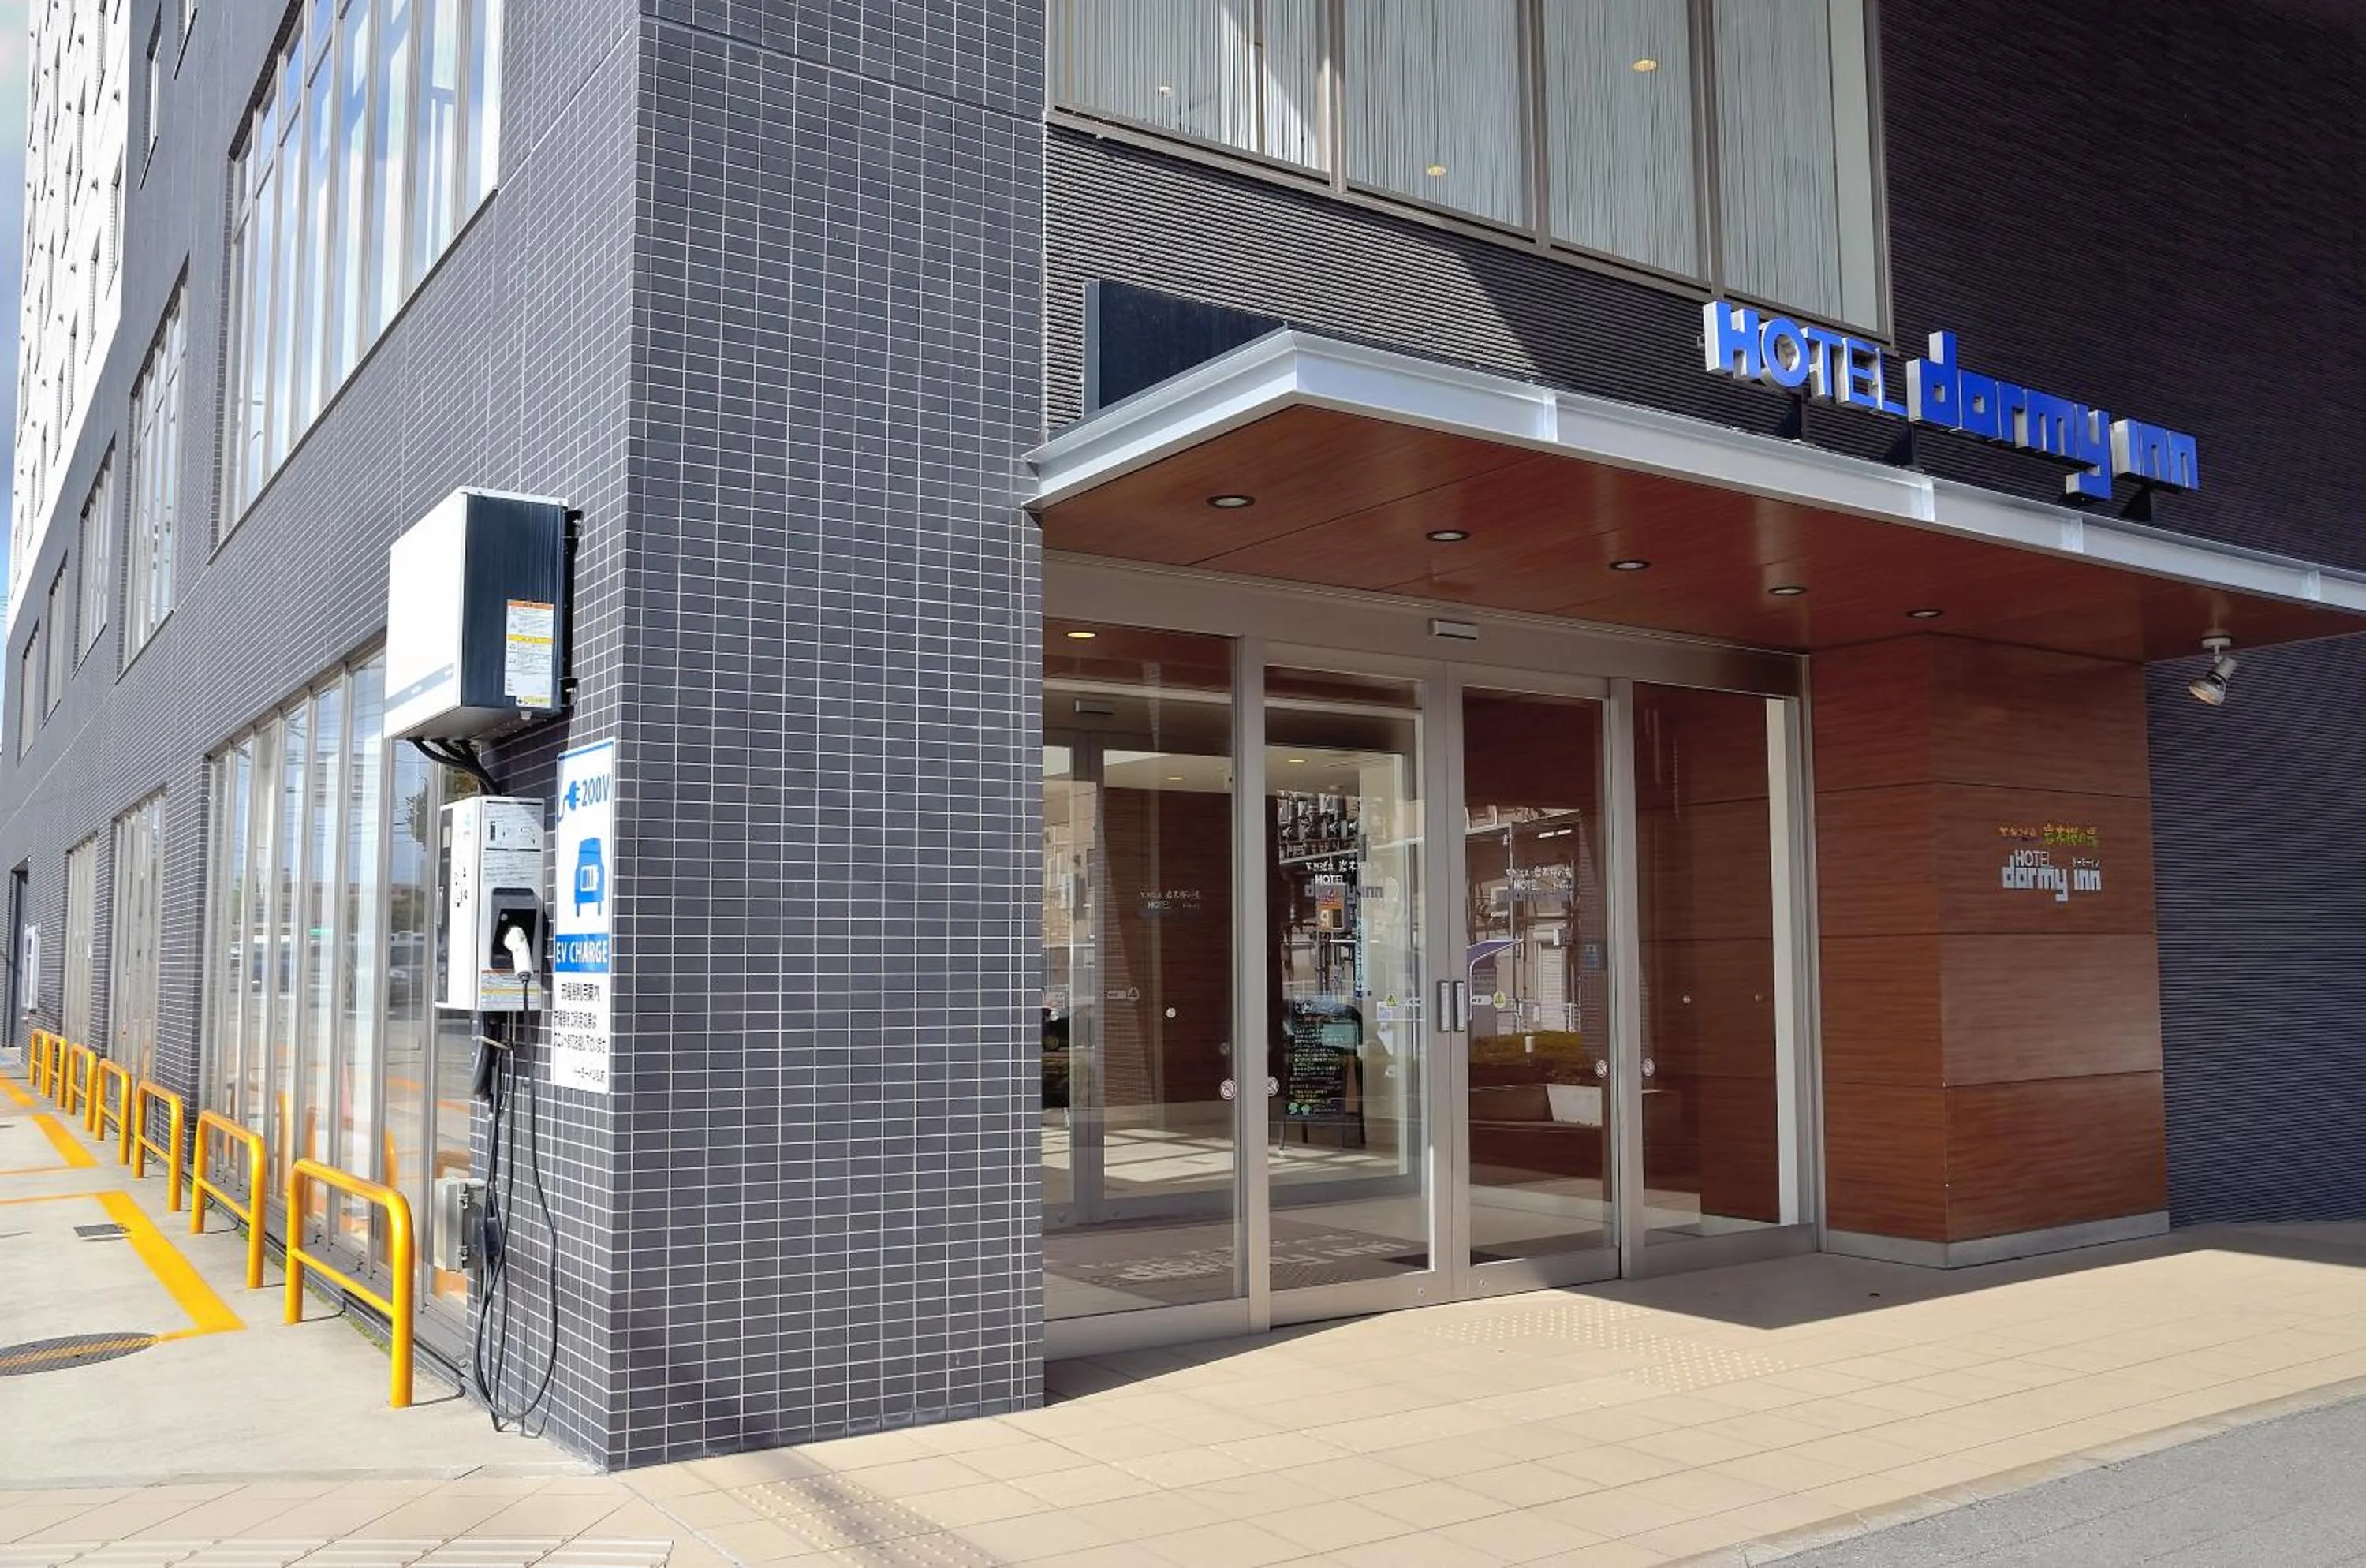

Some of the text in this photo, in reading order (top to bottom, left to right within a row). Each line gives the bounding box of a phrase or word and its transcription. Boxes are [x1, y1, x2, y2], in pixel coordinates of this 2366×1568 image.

[1703, 301, 1907, 417] HOTEL
[1905, 330, 2112, 499] dormy
[582, 773, 610, 806] 200V
[2014, 850, 2053, 867] HOTEL
[1315, 875, 1346, 885] HOTEL
[2002, 854, 2069, 902] dormy
[556, 939, 608, 963] EV CHARGE
